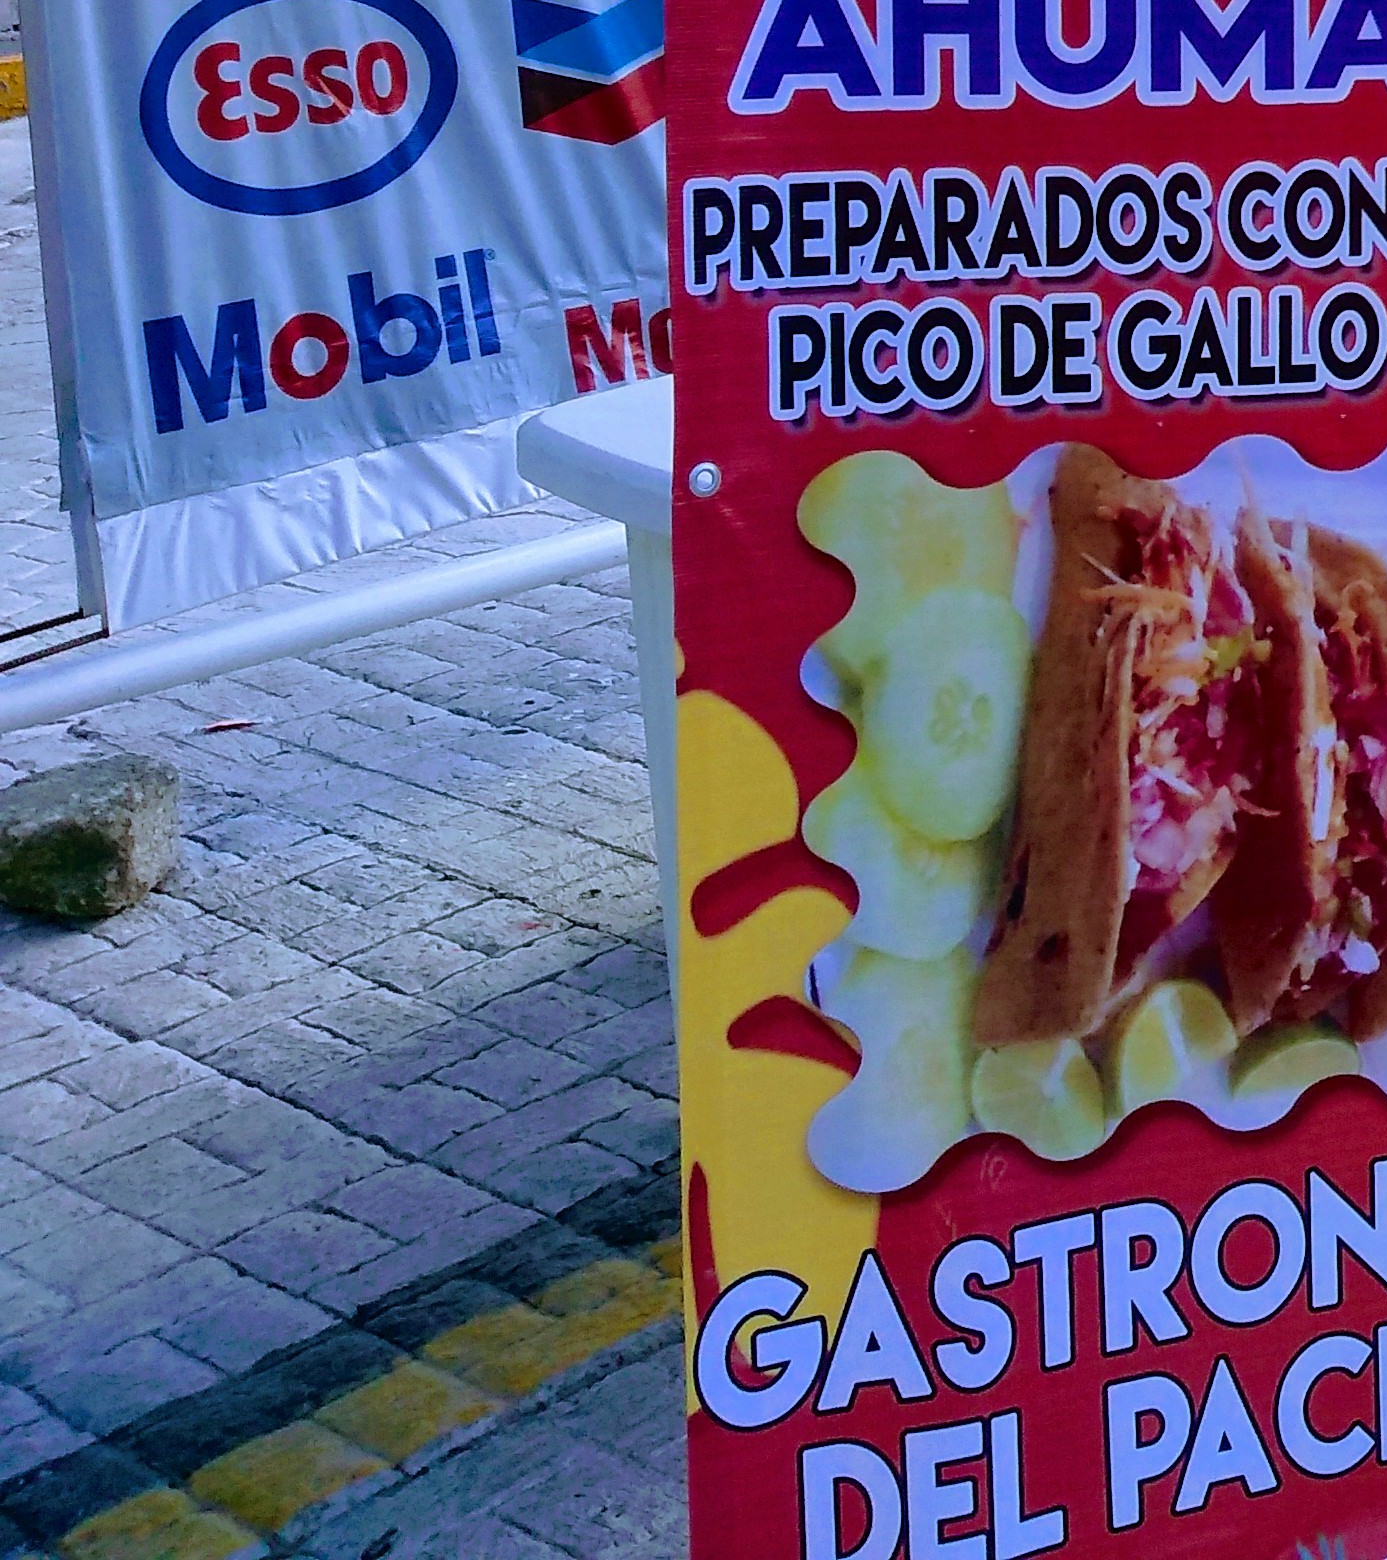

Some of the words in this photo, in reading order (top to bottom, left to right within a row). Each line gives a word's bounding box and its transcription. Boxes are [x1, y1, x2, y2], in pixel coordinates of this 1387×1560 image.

[685, 169, 1211, 297] PREPARADOS
[143, 249, 500, 434] Mobil
[769, 294, 983, 420] PICO
[993, 291, 1104, 404] DE
[800, 1410, 1065, 1560] DEL
